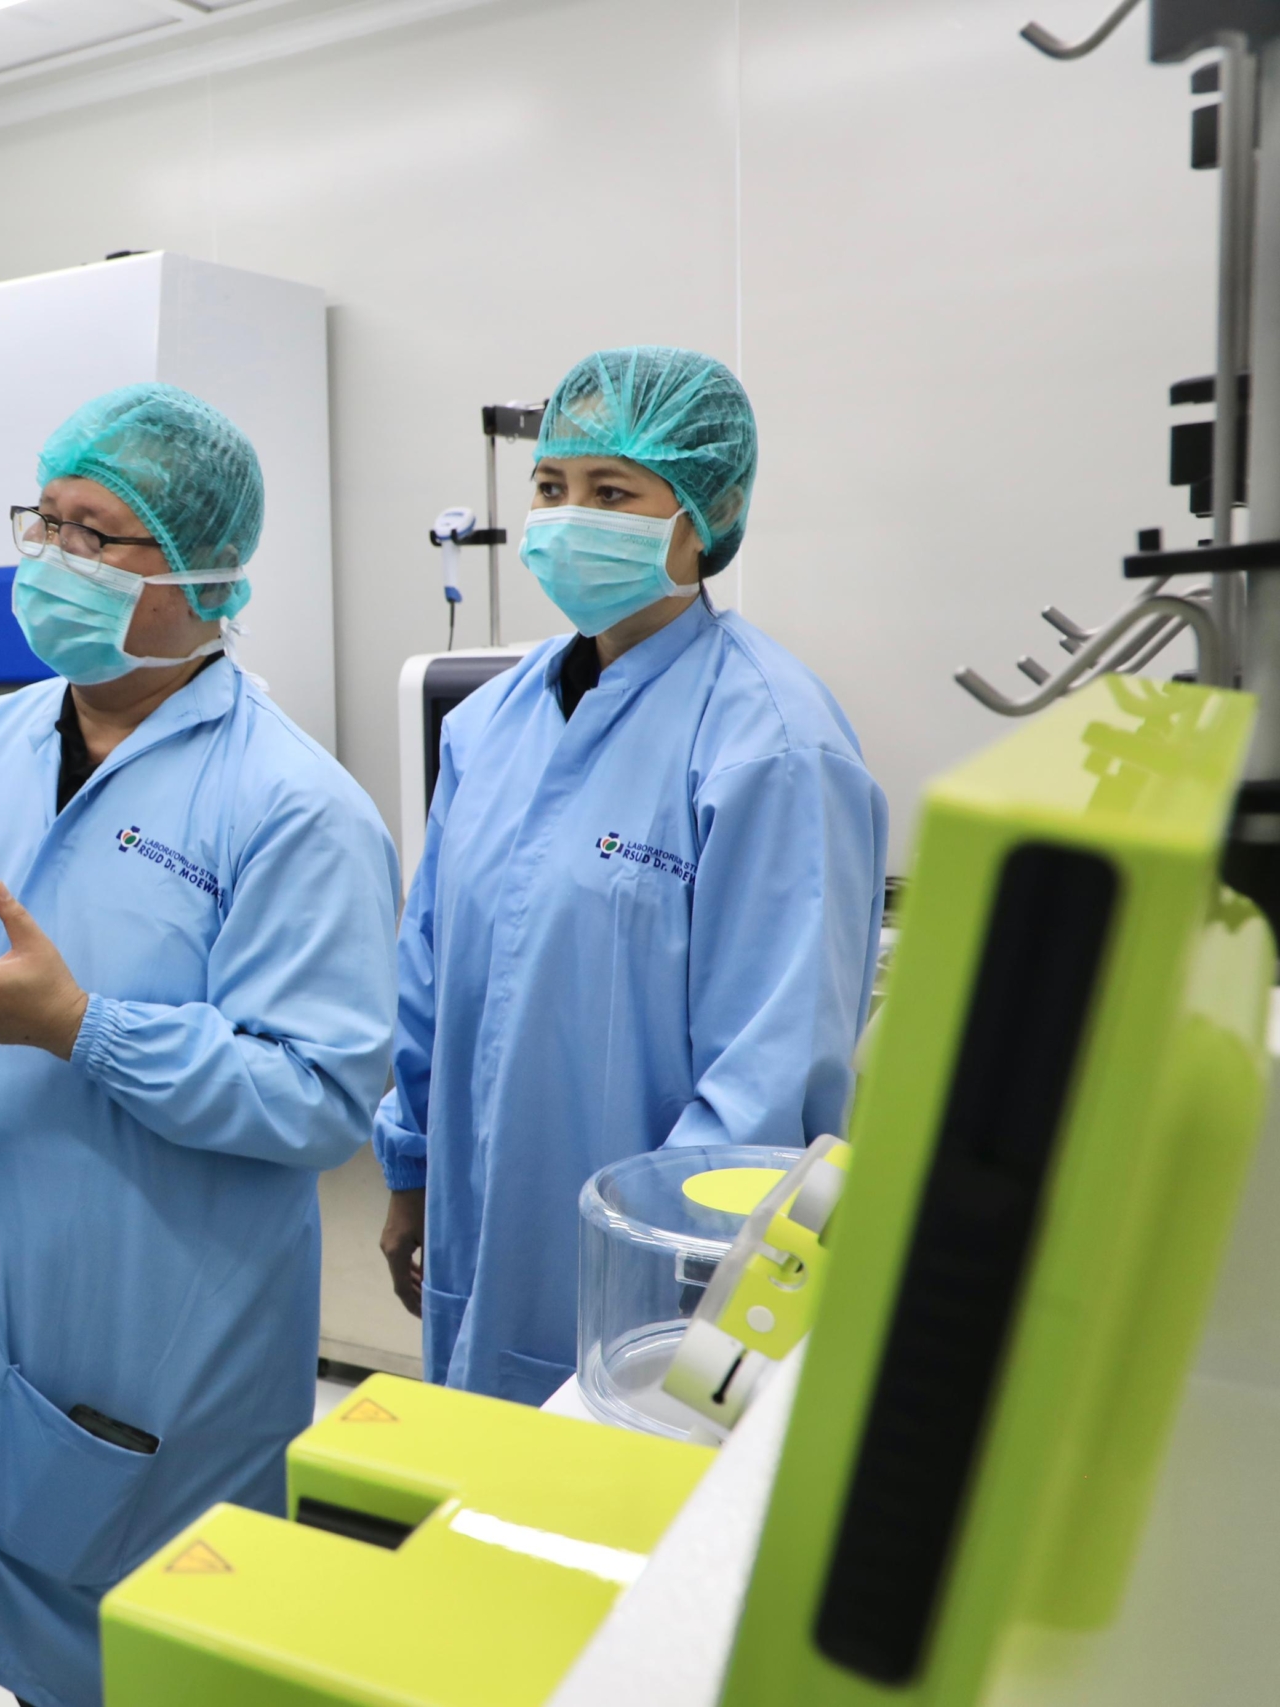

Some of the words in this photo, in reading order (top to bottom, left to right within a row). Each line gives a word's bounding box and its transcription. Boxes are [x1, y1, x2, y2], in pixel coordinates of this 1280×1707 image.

[137, 844, 165, 864] RSUD
[164, 858, 177, 873] Dr.
[144, 837, 199, 872] LABORATORIUM
[622, 848, 650, 864] RSUD
[653, 857, 668, 872] Dr.
